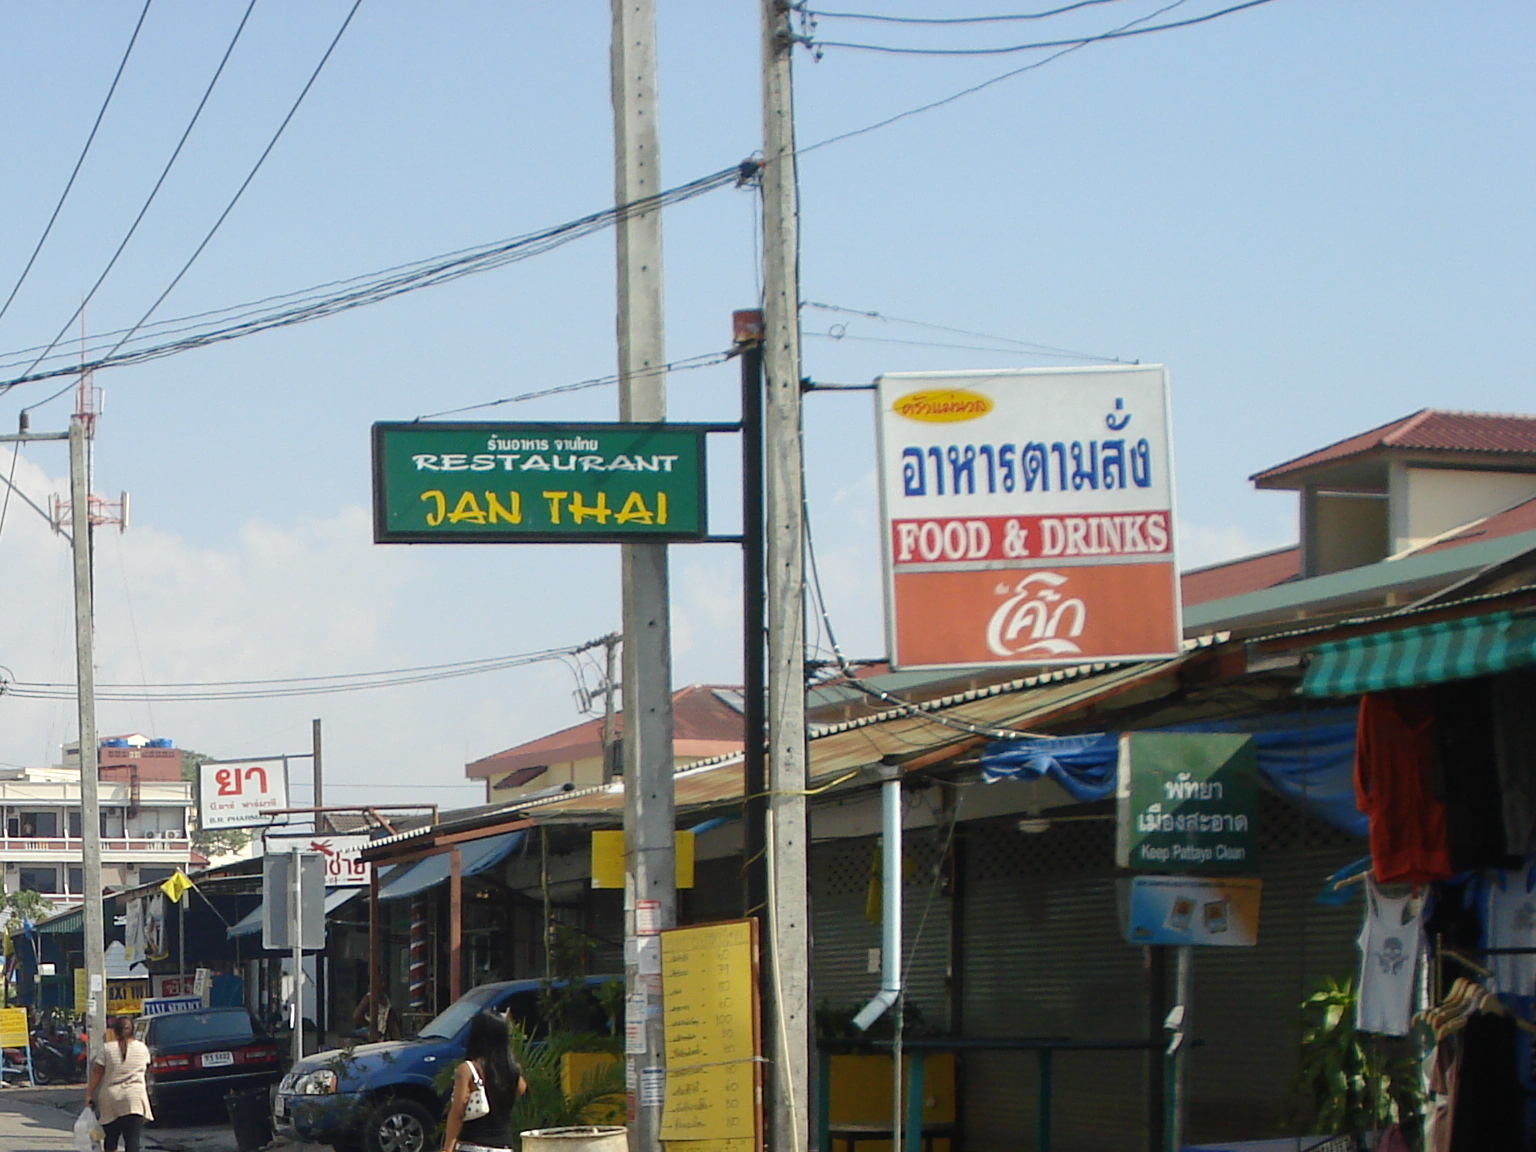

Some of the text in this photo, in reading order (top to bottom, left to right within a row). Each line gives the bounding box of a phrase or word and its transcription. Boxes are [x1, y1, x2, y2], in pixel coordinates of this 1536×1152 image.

[487, 433, 598, 451] ร้านอาหาร จานไทย
[902, 398, 1152, 497] อาหารตามสั่ง
[412, 454, 679, 473] RESTAURANT
[420, 489, 667, 527] JAN THAI
[897, 515, 1168, 561] FOOD & DRINKS
[215, 767, 267, 796] ยา
[1163, 772, 1224, 800] พัทยา
[1137, 803, 1249, 832] เมืองสะอาด
[1140, 844, 1170, 863] Keep
[1172, 844, 1212, 863] Pattaya
